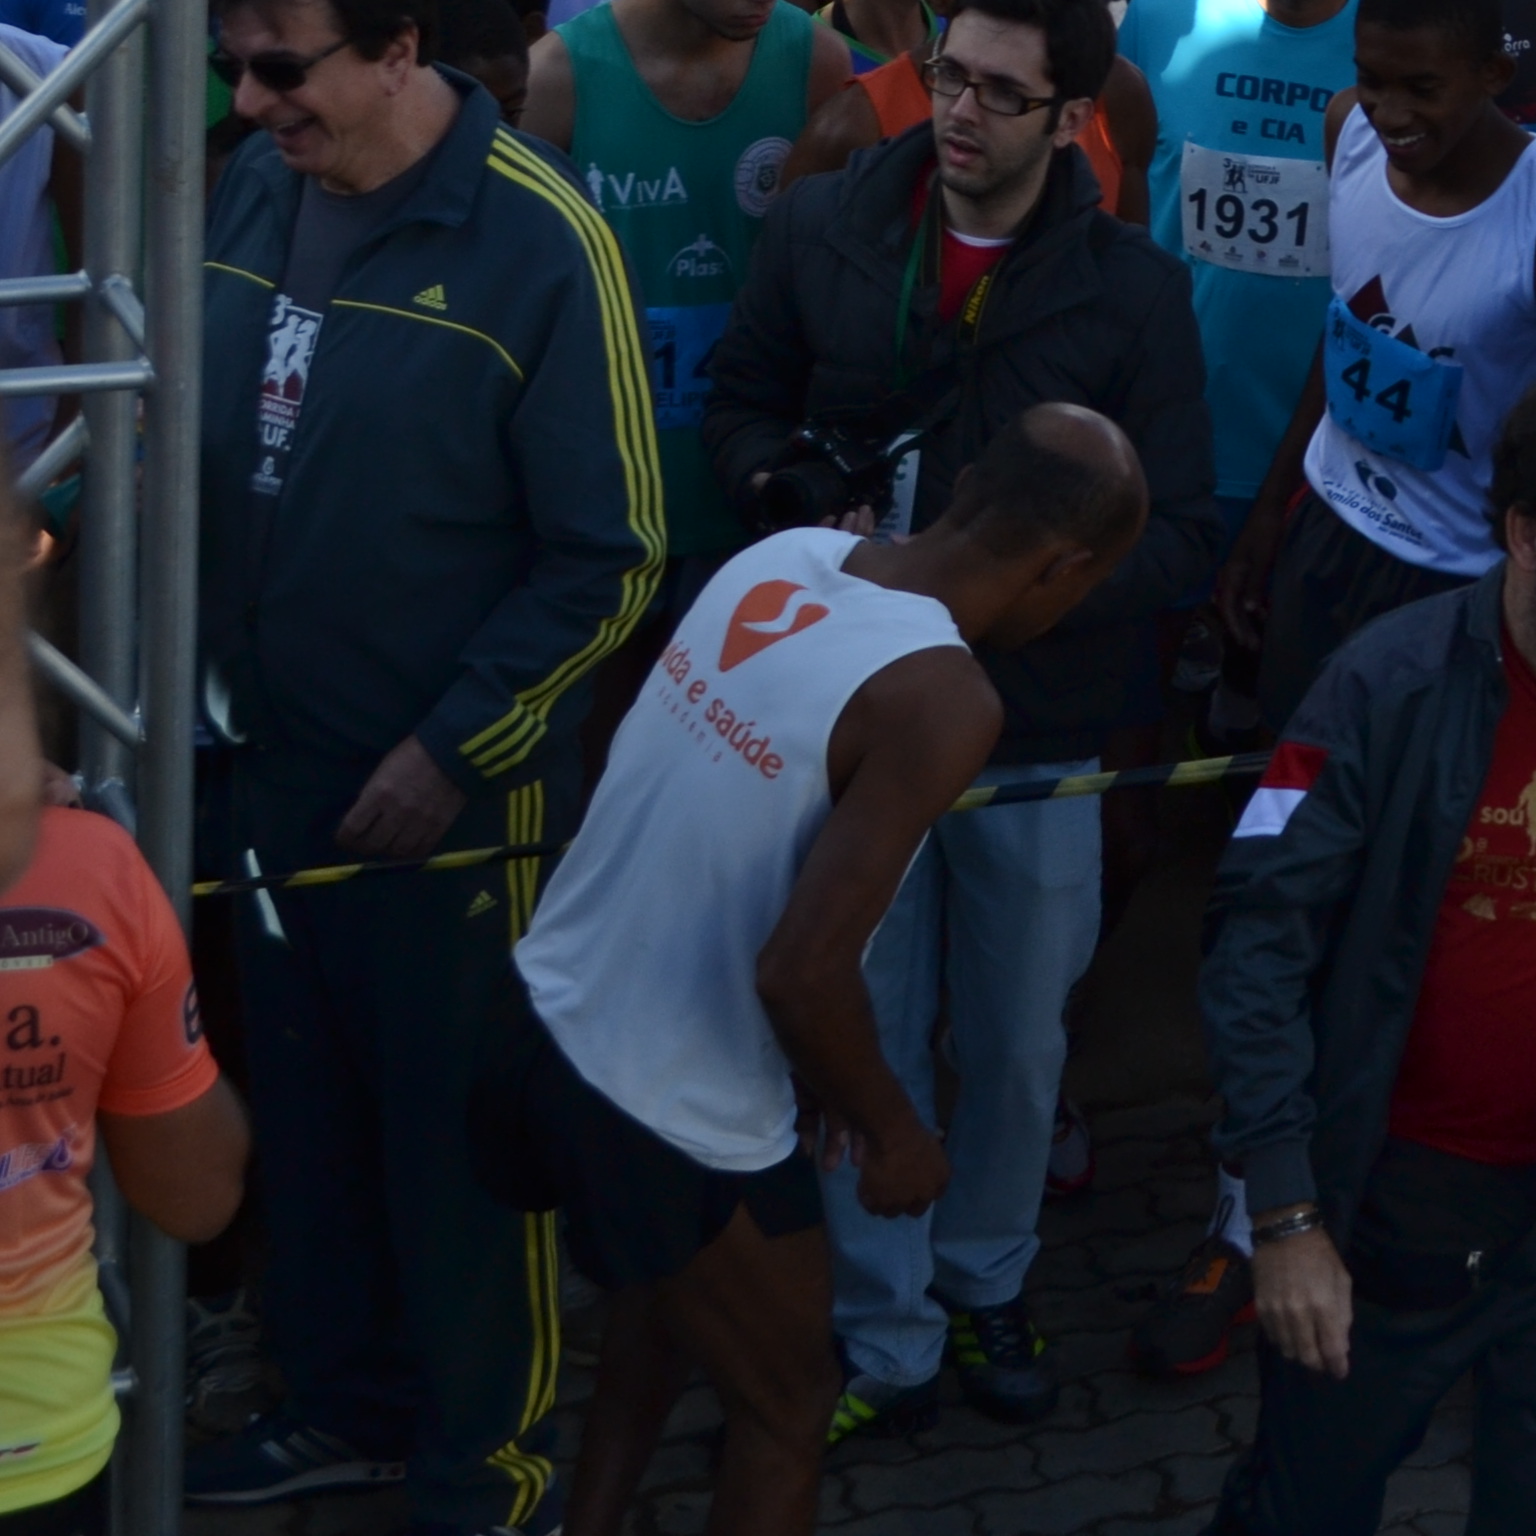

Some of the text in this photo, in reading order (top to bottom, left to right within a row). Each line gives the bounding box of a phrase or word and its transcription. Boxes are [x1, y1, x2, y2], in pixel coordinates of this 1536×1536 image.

[1216, 72, 1334, 114] CORPO
[1231, 118, 1306, 145] e CIA
[1188, 187, 1309, 247] 1931
[963, 275, 990, 325] Nikon
[1341, 358, 1412, 424] 44
[1360, 503, 1382, 522] dos
[687, 679, 708, 704] e
[704, 699, 784, 780] saúde
[1479, 805, 1525, 827] sou
